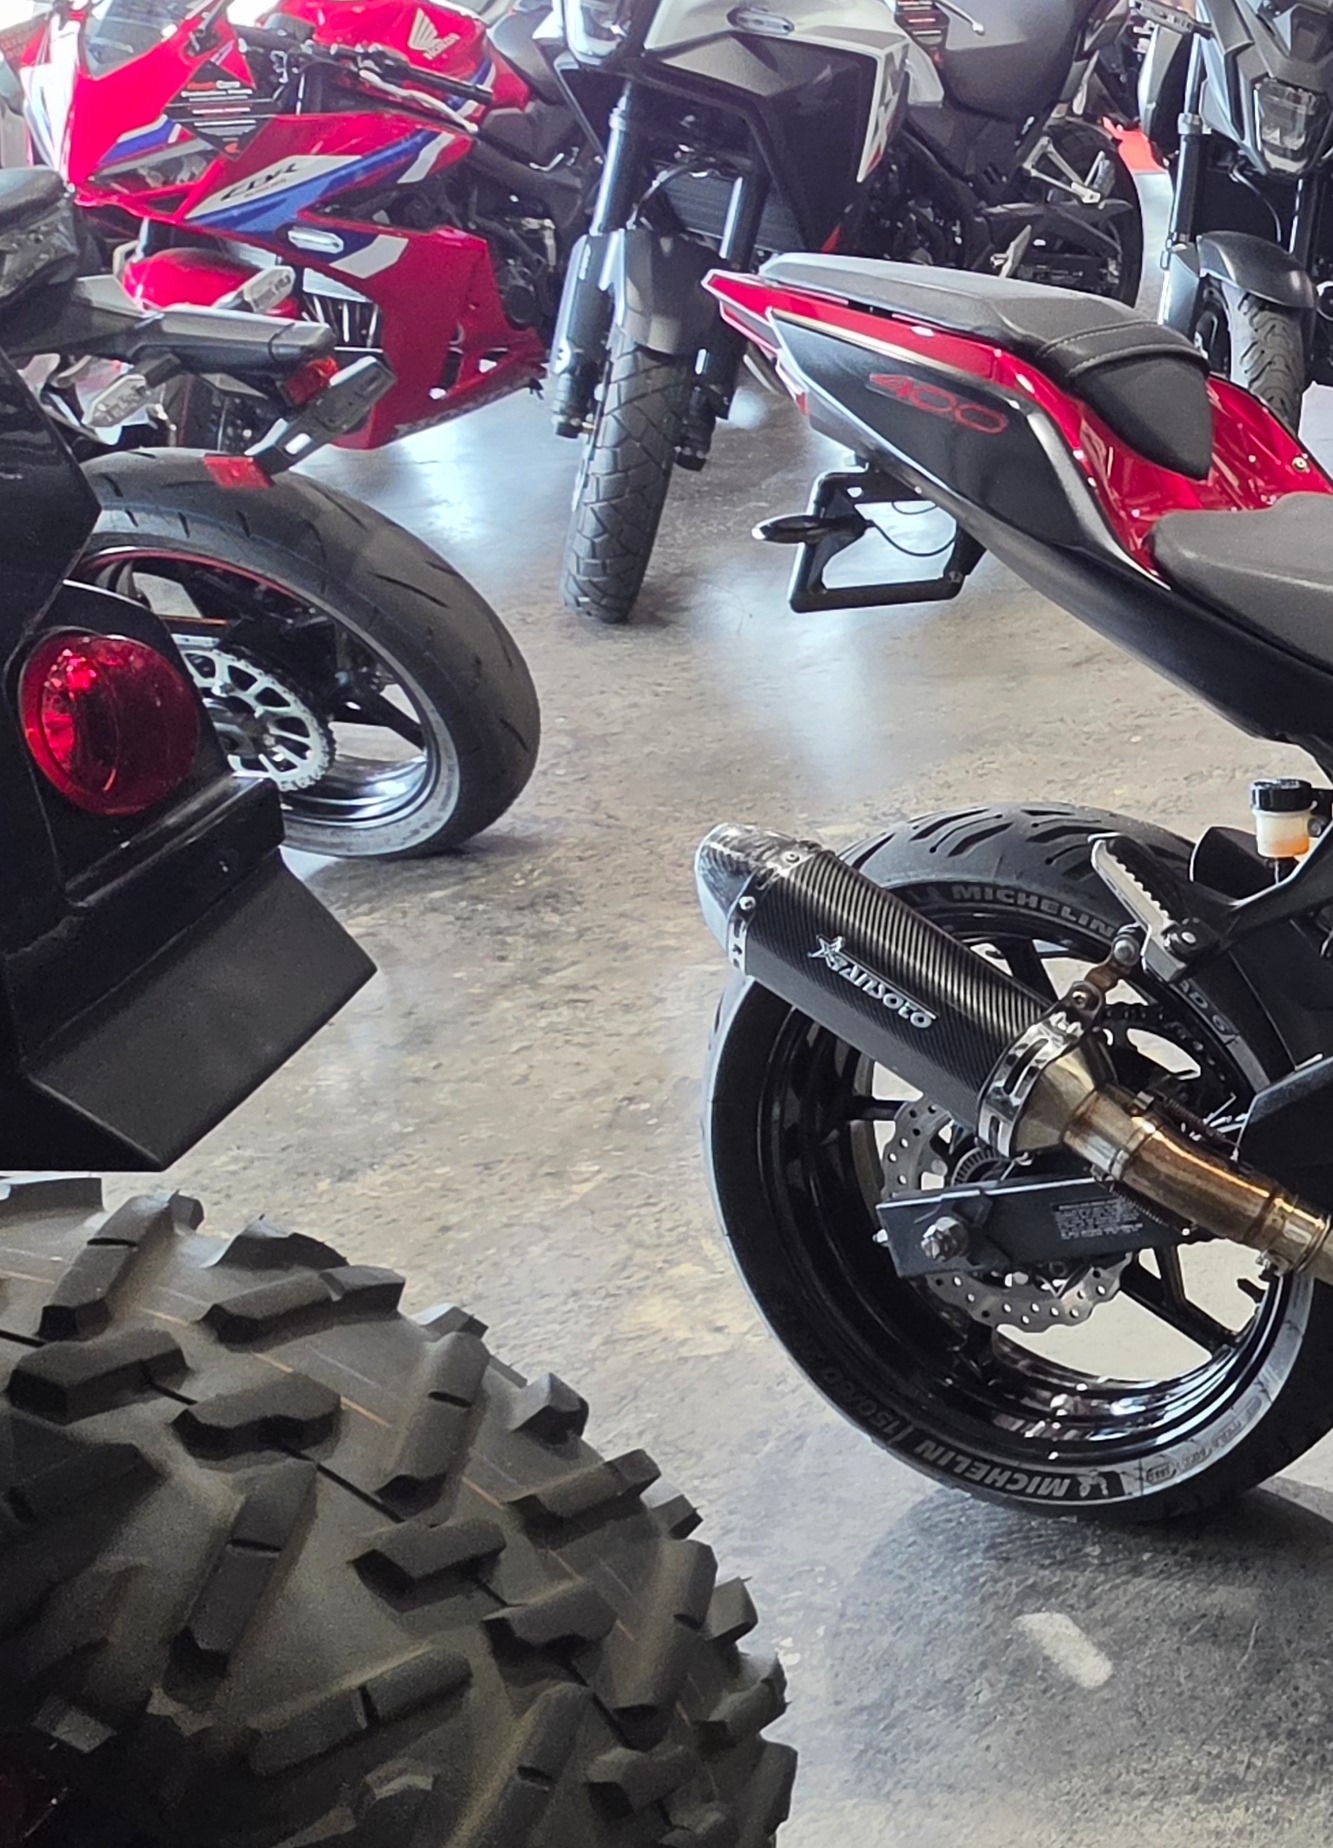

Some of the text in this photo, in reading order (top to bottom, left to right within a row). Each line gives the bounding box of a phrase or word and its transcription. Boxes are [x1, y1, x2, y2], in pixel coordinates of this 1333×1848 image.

[869, 373, 1008, 435] 400
[952, 885, 1114, 938] MICHELIN
[915, 1438, 1071, 1498] MICHELIN
